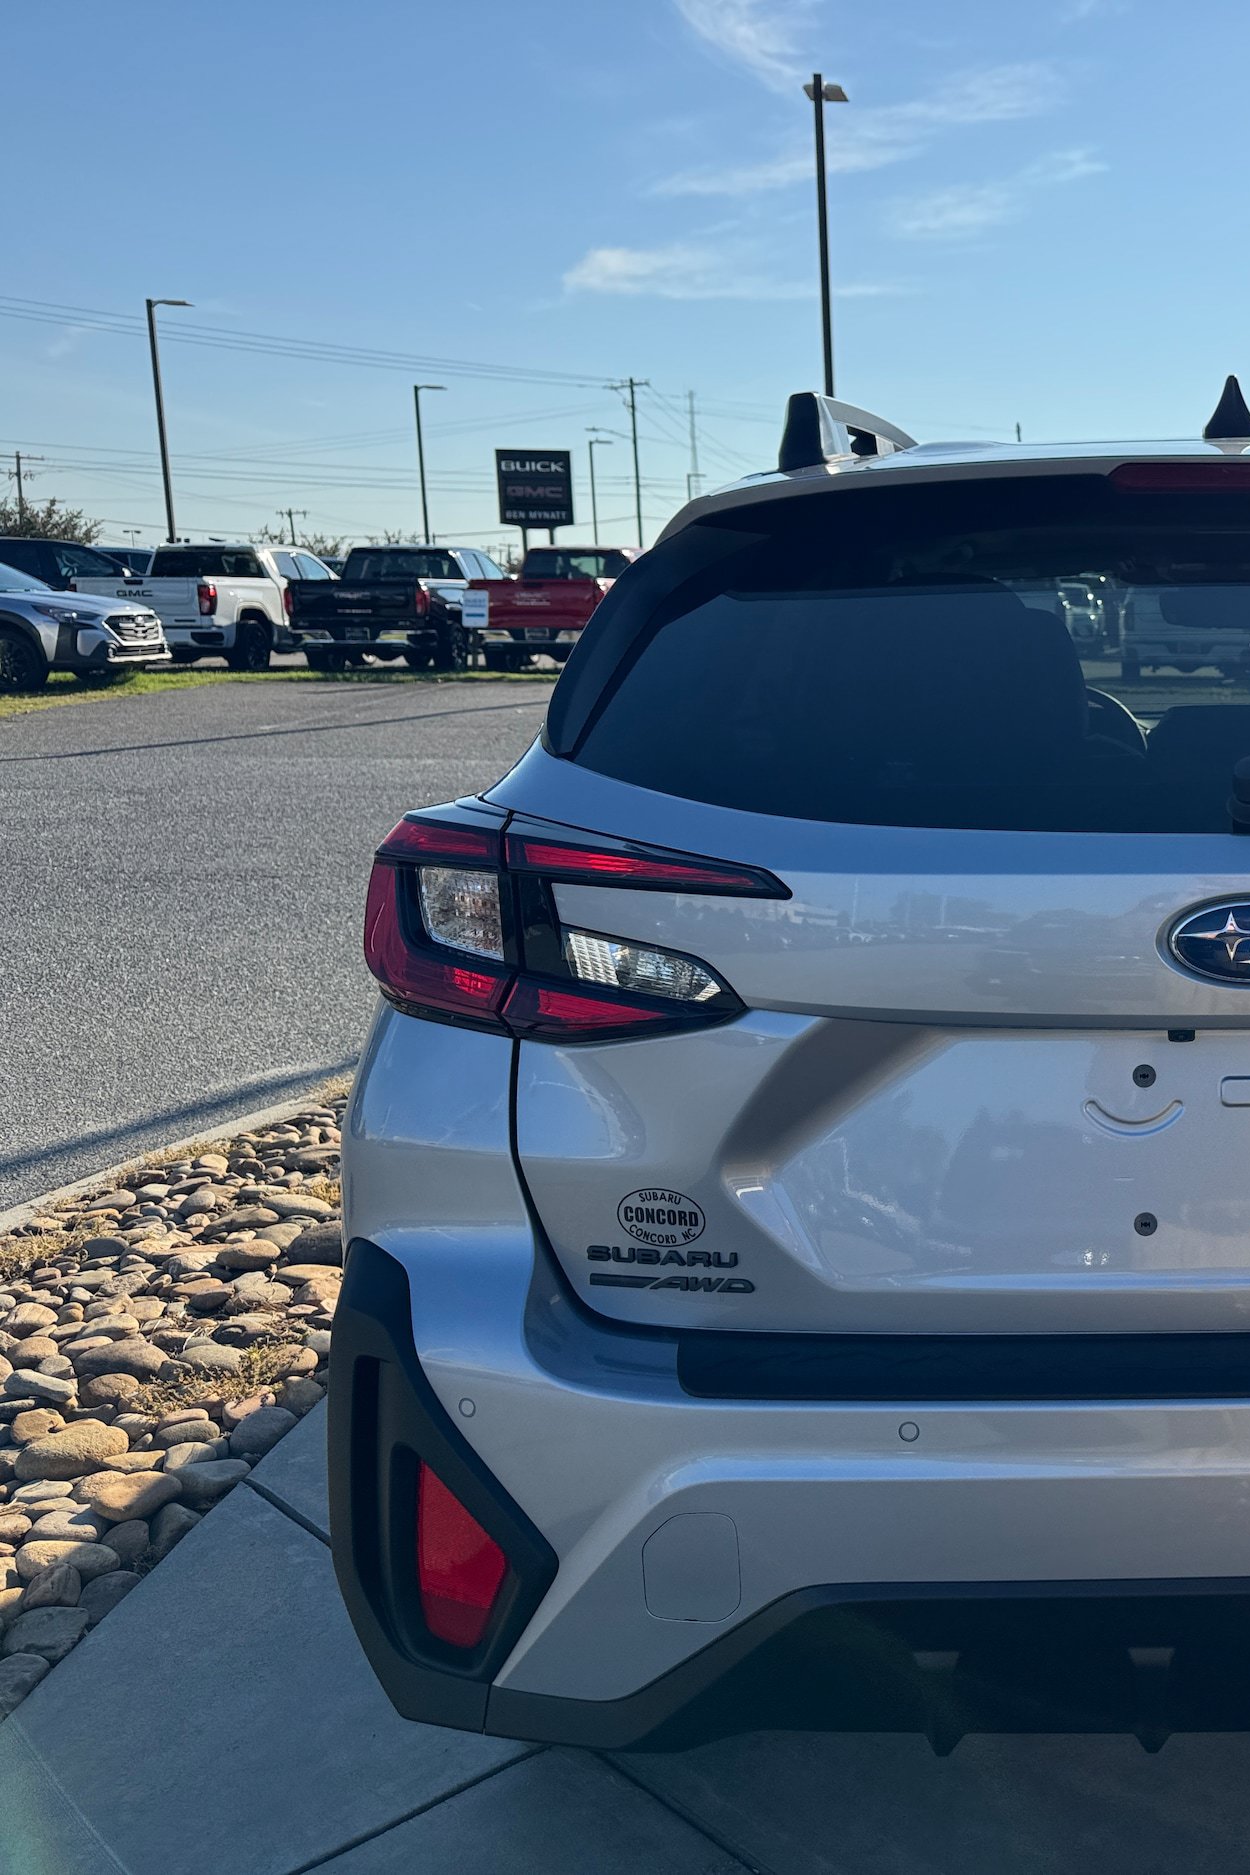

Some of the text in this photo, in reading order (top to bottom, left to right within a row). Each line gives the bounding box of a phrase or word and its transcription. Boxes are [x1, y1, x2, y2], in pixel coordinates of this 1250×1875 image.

[500, 460, 565, 473] BUICK
[506, 486, 563, 498] GMC
[505, 510, 567, 520] BEN MYNATT
[116, 589, 153, 598] GMC
[638, 1191, 682, 1205] SUBARU
[623, 1205, 699, 1227] CONCORD
[629, 1224, 697, 1245] CONCORD NC
[586, 1245, 739, 1268] SUBARU
[649, 1275, 756, 1294] AWD
